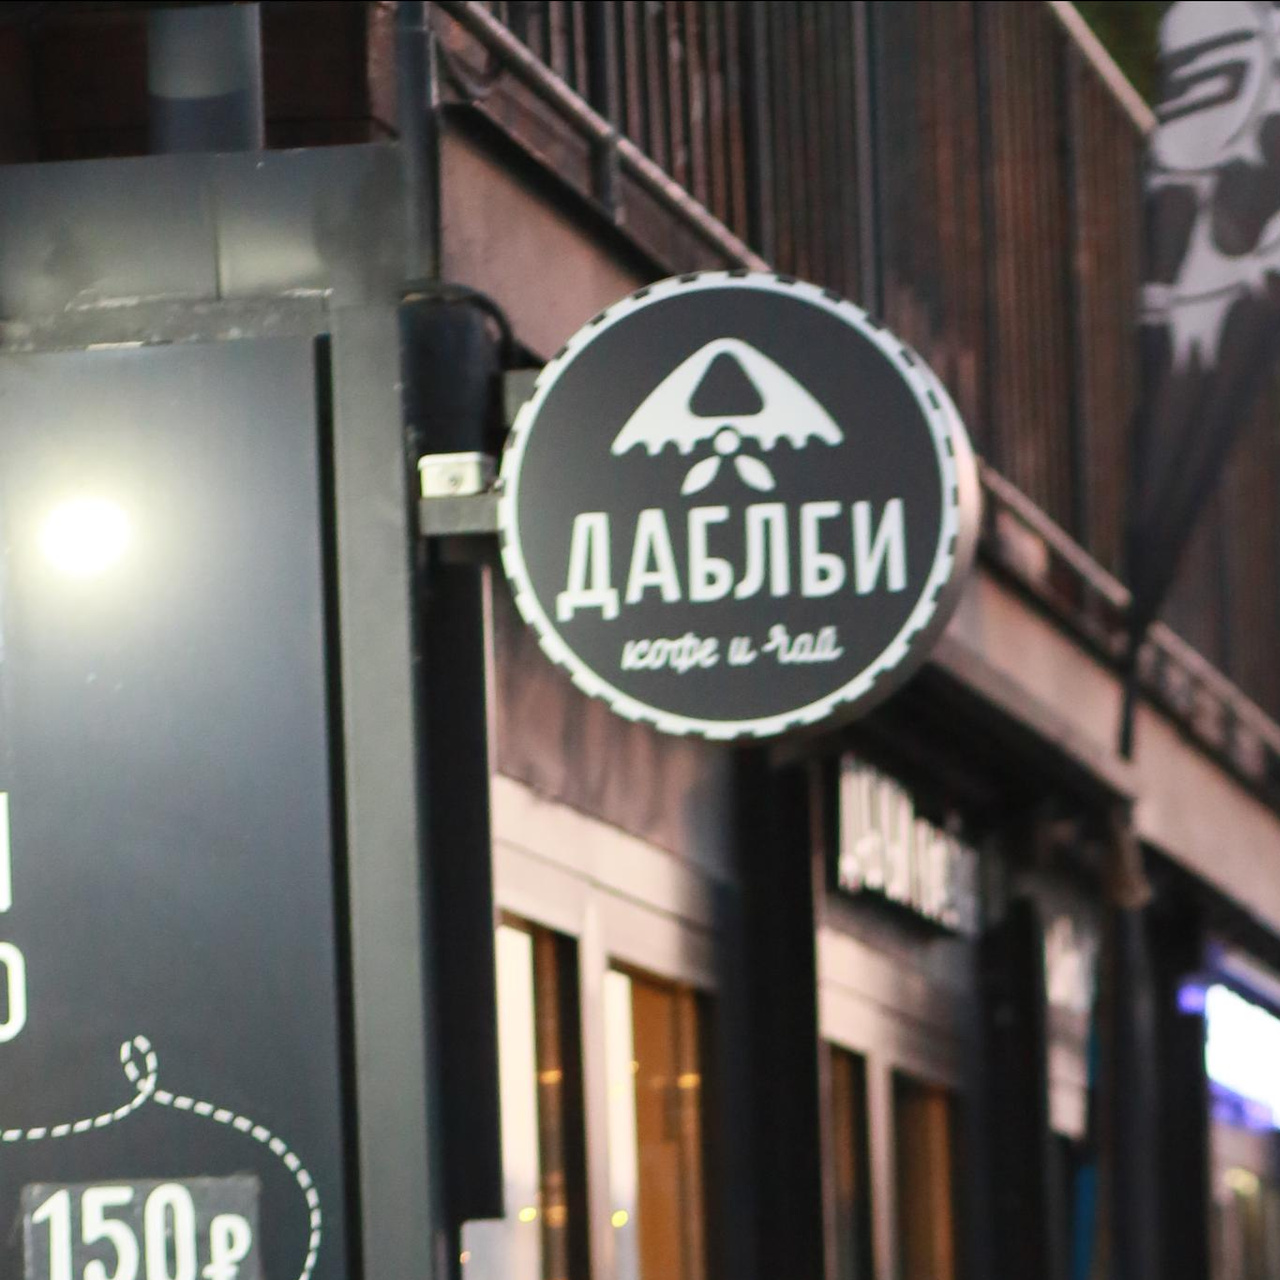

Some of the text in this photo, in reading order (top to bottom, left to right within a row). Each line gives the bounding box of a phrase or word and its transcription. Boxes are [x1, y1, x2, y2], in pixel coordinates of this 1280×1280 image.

[556, 498, 908, 622] ДАБЛБИ
[621, 631, 720, 674] кофе
[727, 635, 758, 666] и
